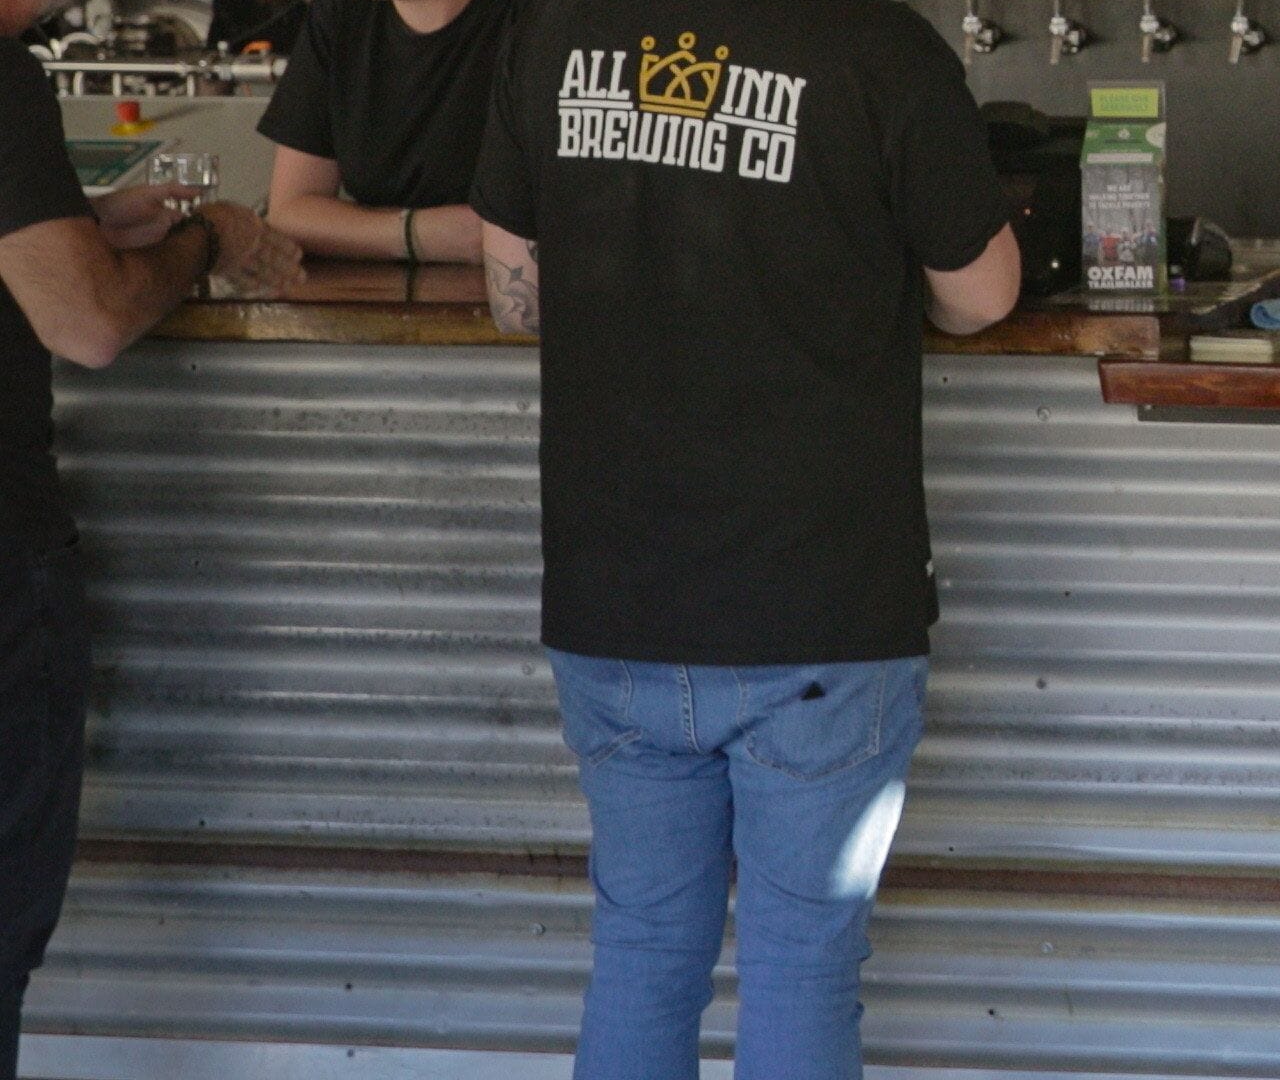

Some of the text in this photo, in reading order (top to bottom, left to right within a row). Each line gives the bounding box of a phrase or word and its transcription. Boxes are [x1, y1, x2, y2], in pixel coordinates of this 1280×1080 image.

[558, 49, 806, 125] ALL INN
[557, 108, 795, 183] BREWING CO
[1087, 265, 1154, 280] OXFAM
